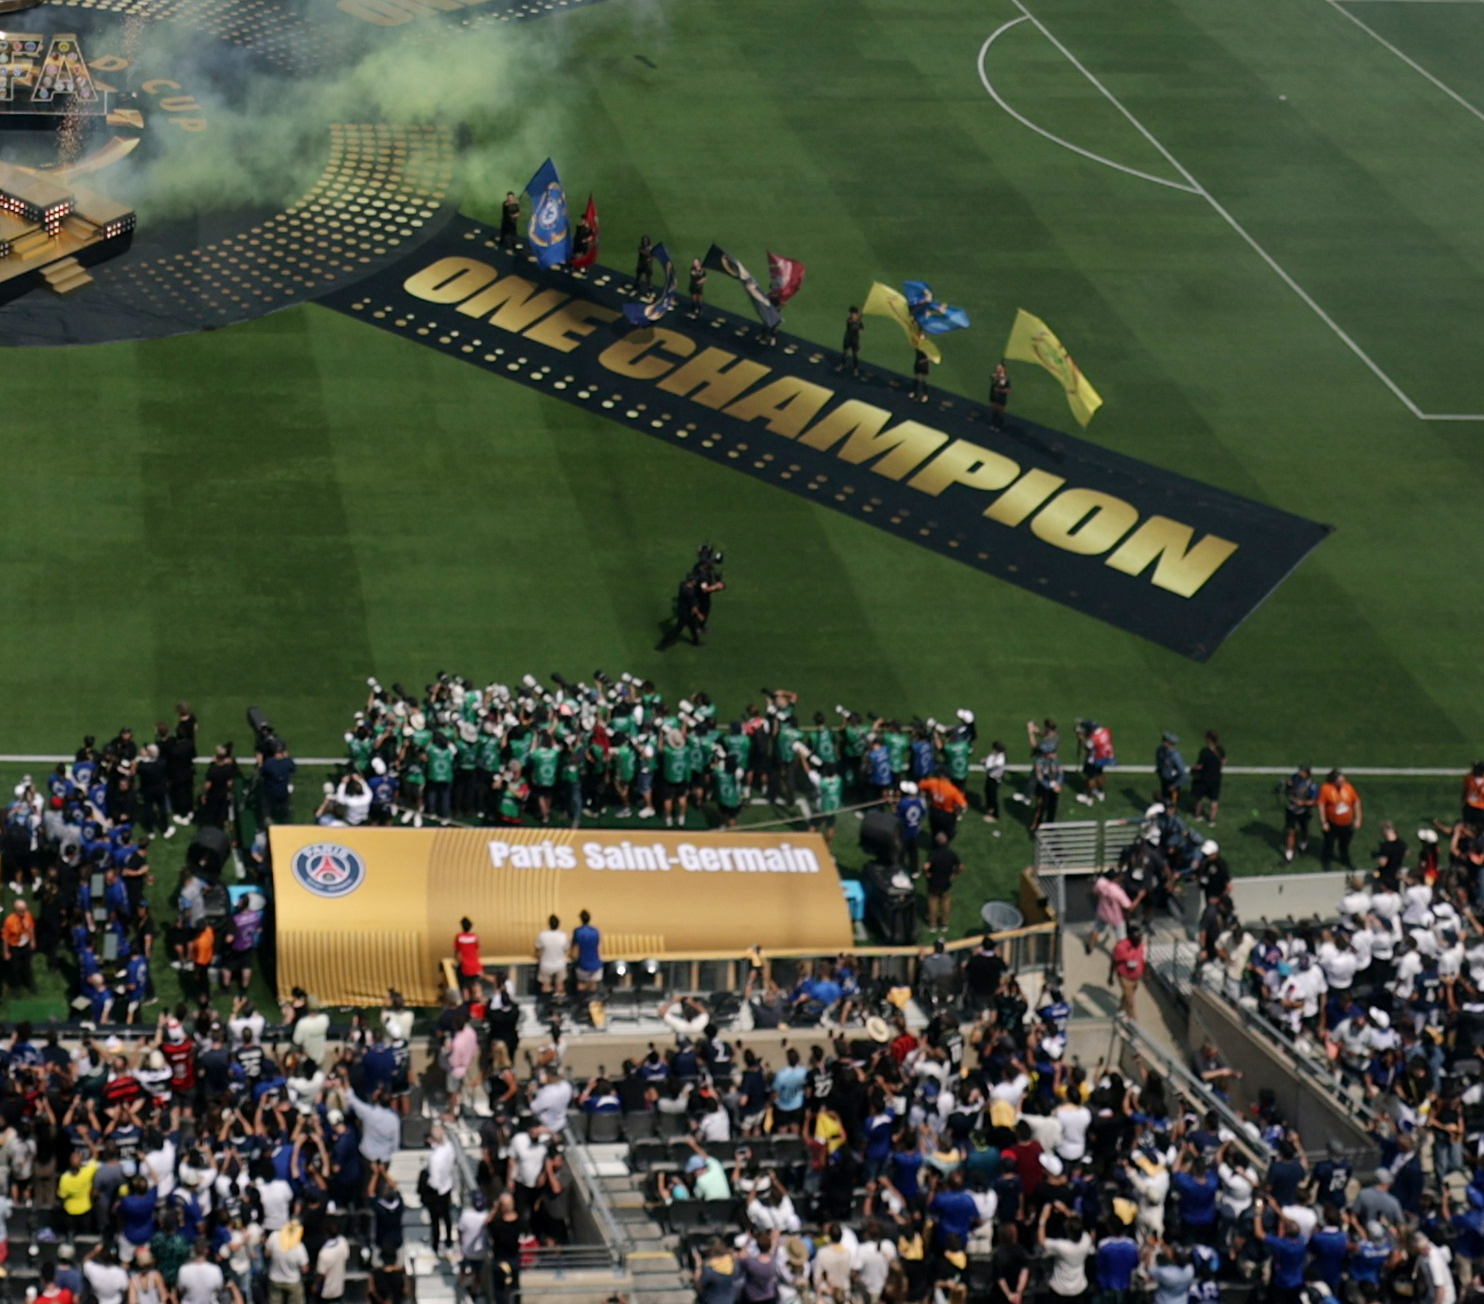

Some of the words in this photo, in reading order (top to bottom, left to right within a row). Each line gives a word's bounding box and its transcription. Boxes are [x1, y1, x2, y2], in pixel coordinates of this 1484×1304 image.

[402, 254, 625, 354] ONE
[596, 327, 1239, 598] CHAMPION
[488, 840, 577, 870] Paris
[585, 842, 821, 874] Saint-Germain
